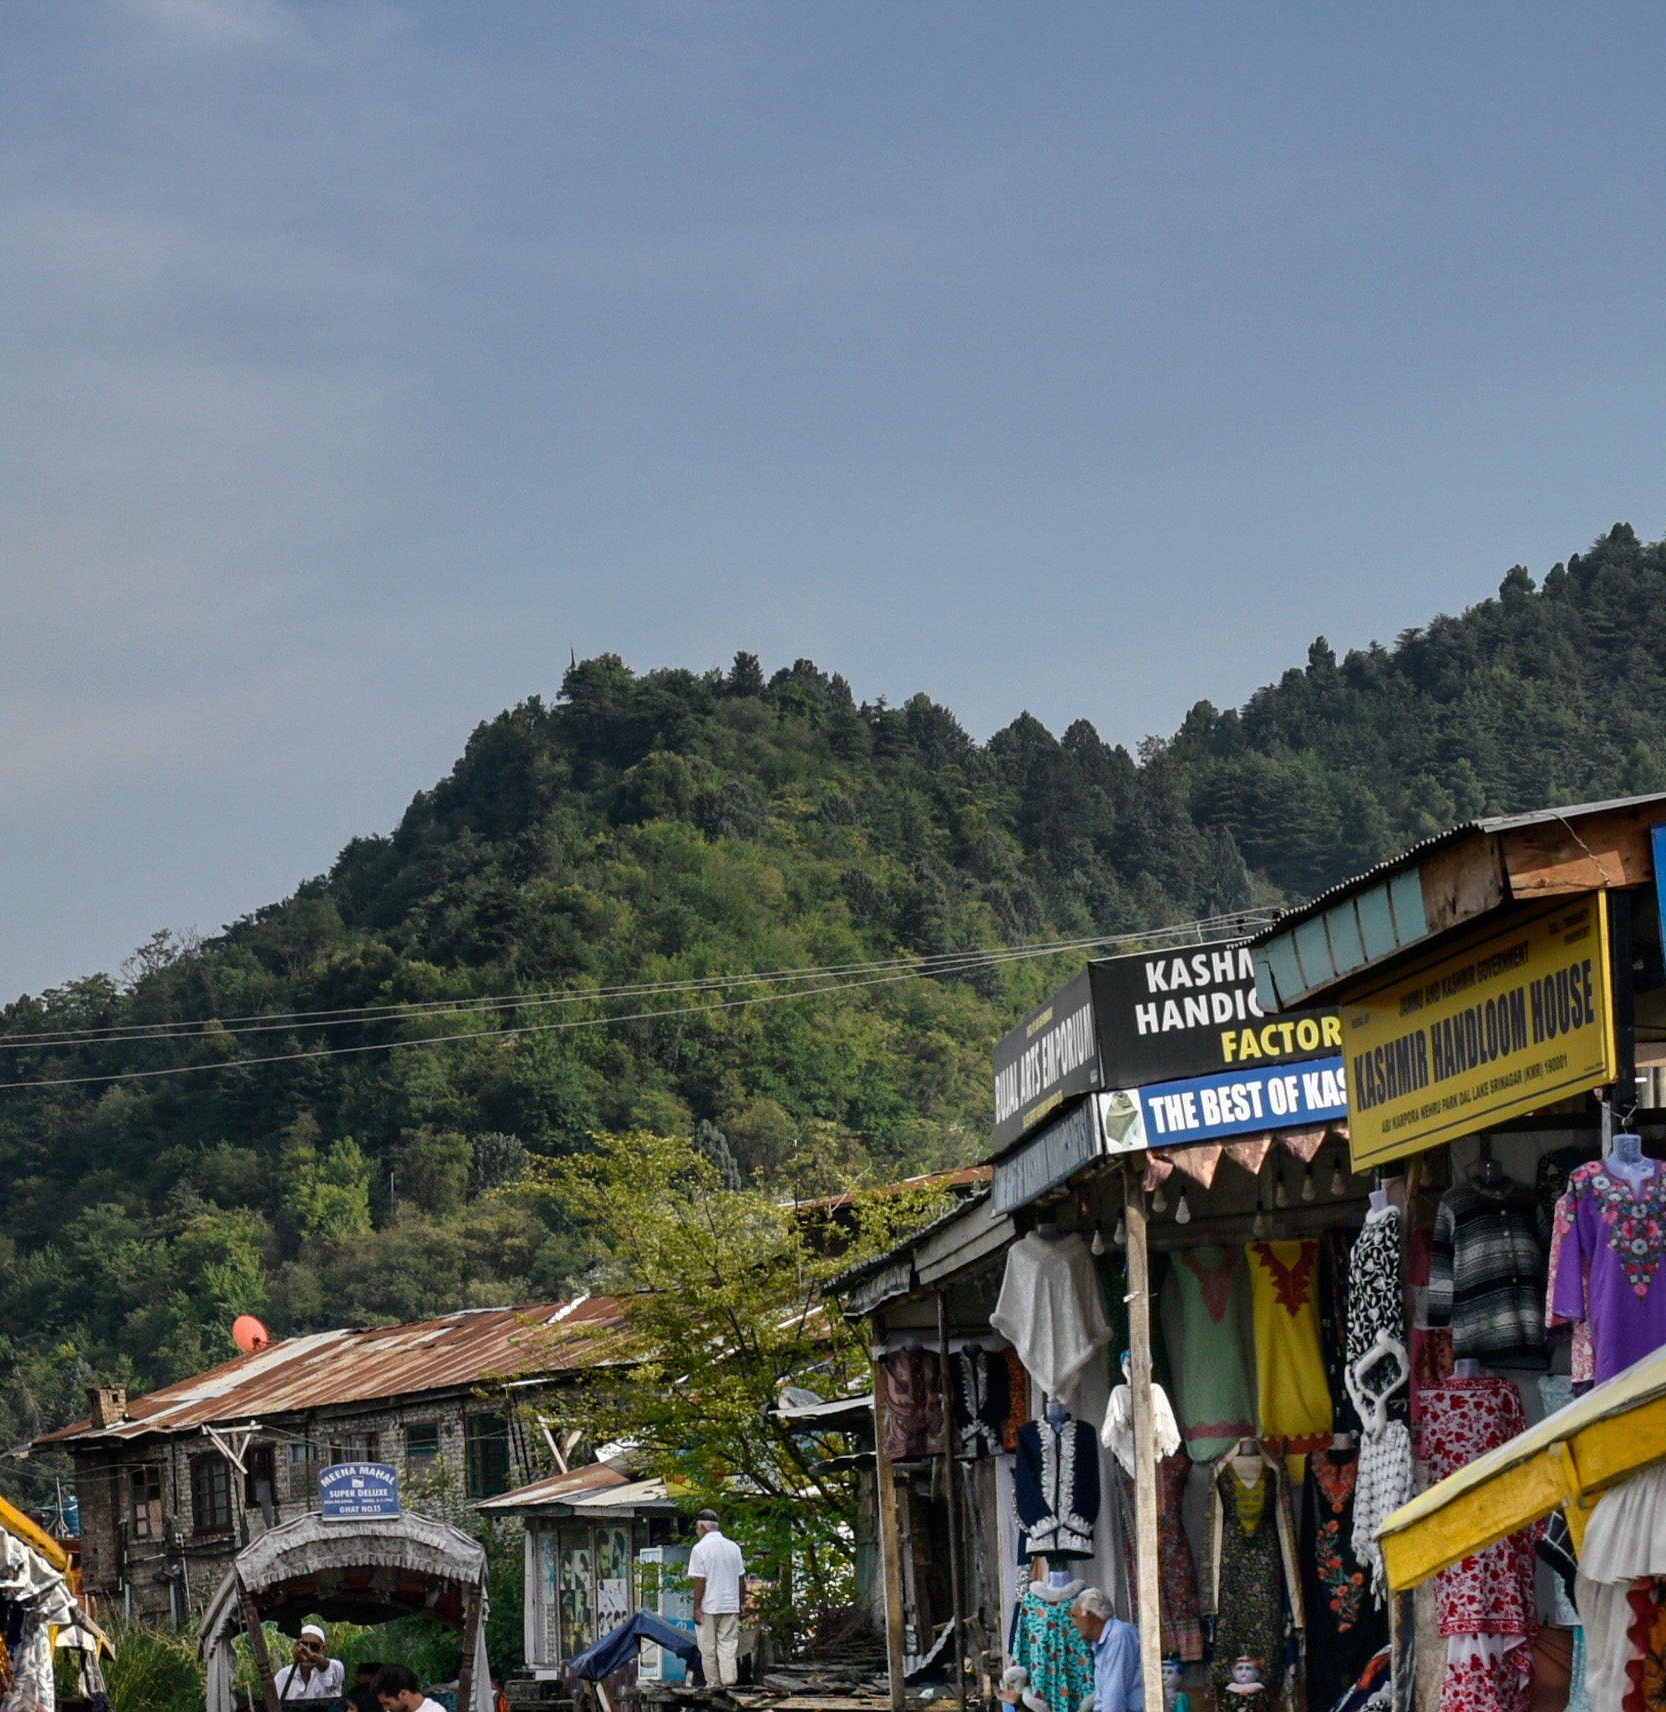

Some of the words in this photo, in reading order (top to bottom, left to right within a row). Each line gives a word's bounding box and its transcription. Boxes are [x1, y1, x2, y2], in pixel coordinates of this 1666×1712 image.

[1399, 988, 1424, 1018] JAMMU
[1426, 980, 1441, 1006] AND
[1442, 964, 1476, 999] KASHMIR
[1477, 940, 1529, 983] GOVERNMENT
[1135, 986, 1265, 1036] HANDIC
[1353, 1028, 1430, 1113] KASHMIR
[1431, 986, 1528, 1083] HANDLOOM
[1530, 958, 1595, 1045] HOUSE
[1020, 1040, 1041, 1108] ARTS
[1041, 1002, 1095, 1090] EMPORIUM
[1221, 1015, 1342, 1063] FACTOR
[1148, 1092, 1200, 1134] THE
[1200, 1081, 1264, 1127] BEST
[1267, 1074, 1299, 1116] OF
[1421, 1101, 1441, 1119] NEHRU
[1442, 1093, 1459, 1112] PARK
[1459, 1089, 1472, 1106] DAL
[1472, 1081, 1489, 1101] LAKE
[1489, 1069, 1523, 1094] SRINAGAR
[320, 1467, 356, 1487] MEENA
[359, 1467, 395, 1485] MAHAL
[330, 1490, 355, 1498] SUPER
[358, 1489, 389, 1497] DELUXE
